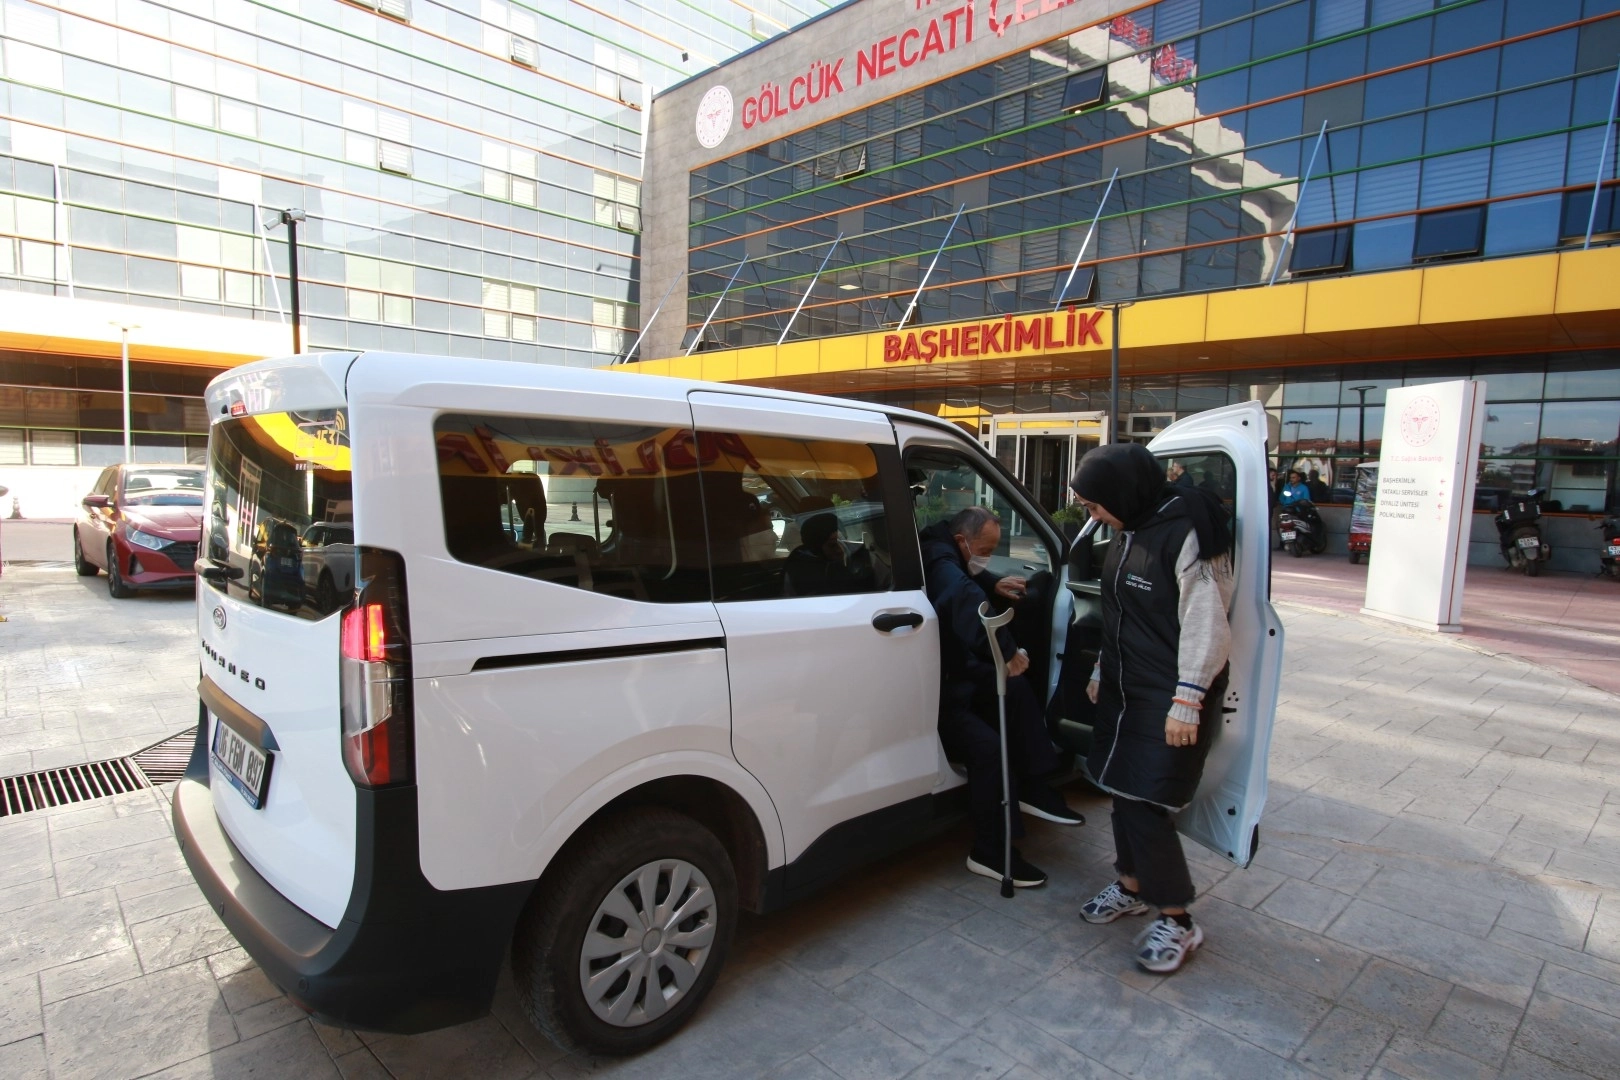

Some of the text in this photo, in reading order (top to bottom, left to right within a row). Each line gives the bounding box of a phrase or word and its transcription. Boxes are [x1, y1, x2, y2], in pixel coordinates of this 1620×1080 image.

[741, 0, 1075, 130] GÖLCÜK NECATİ ÇEL
[883, 304, 1105, 364] BAŞHEKİMLİK
[1383, 477, 1416, 485] BAŞHEKİMLİK
[1401, 489, 1428, 497] SERVİSLER
[1379, 511, 1415, 520] POLİKLİNİKLER
